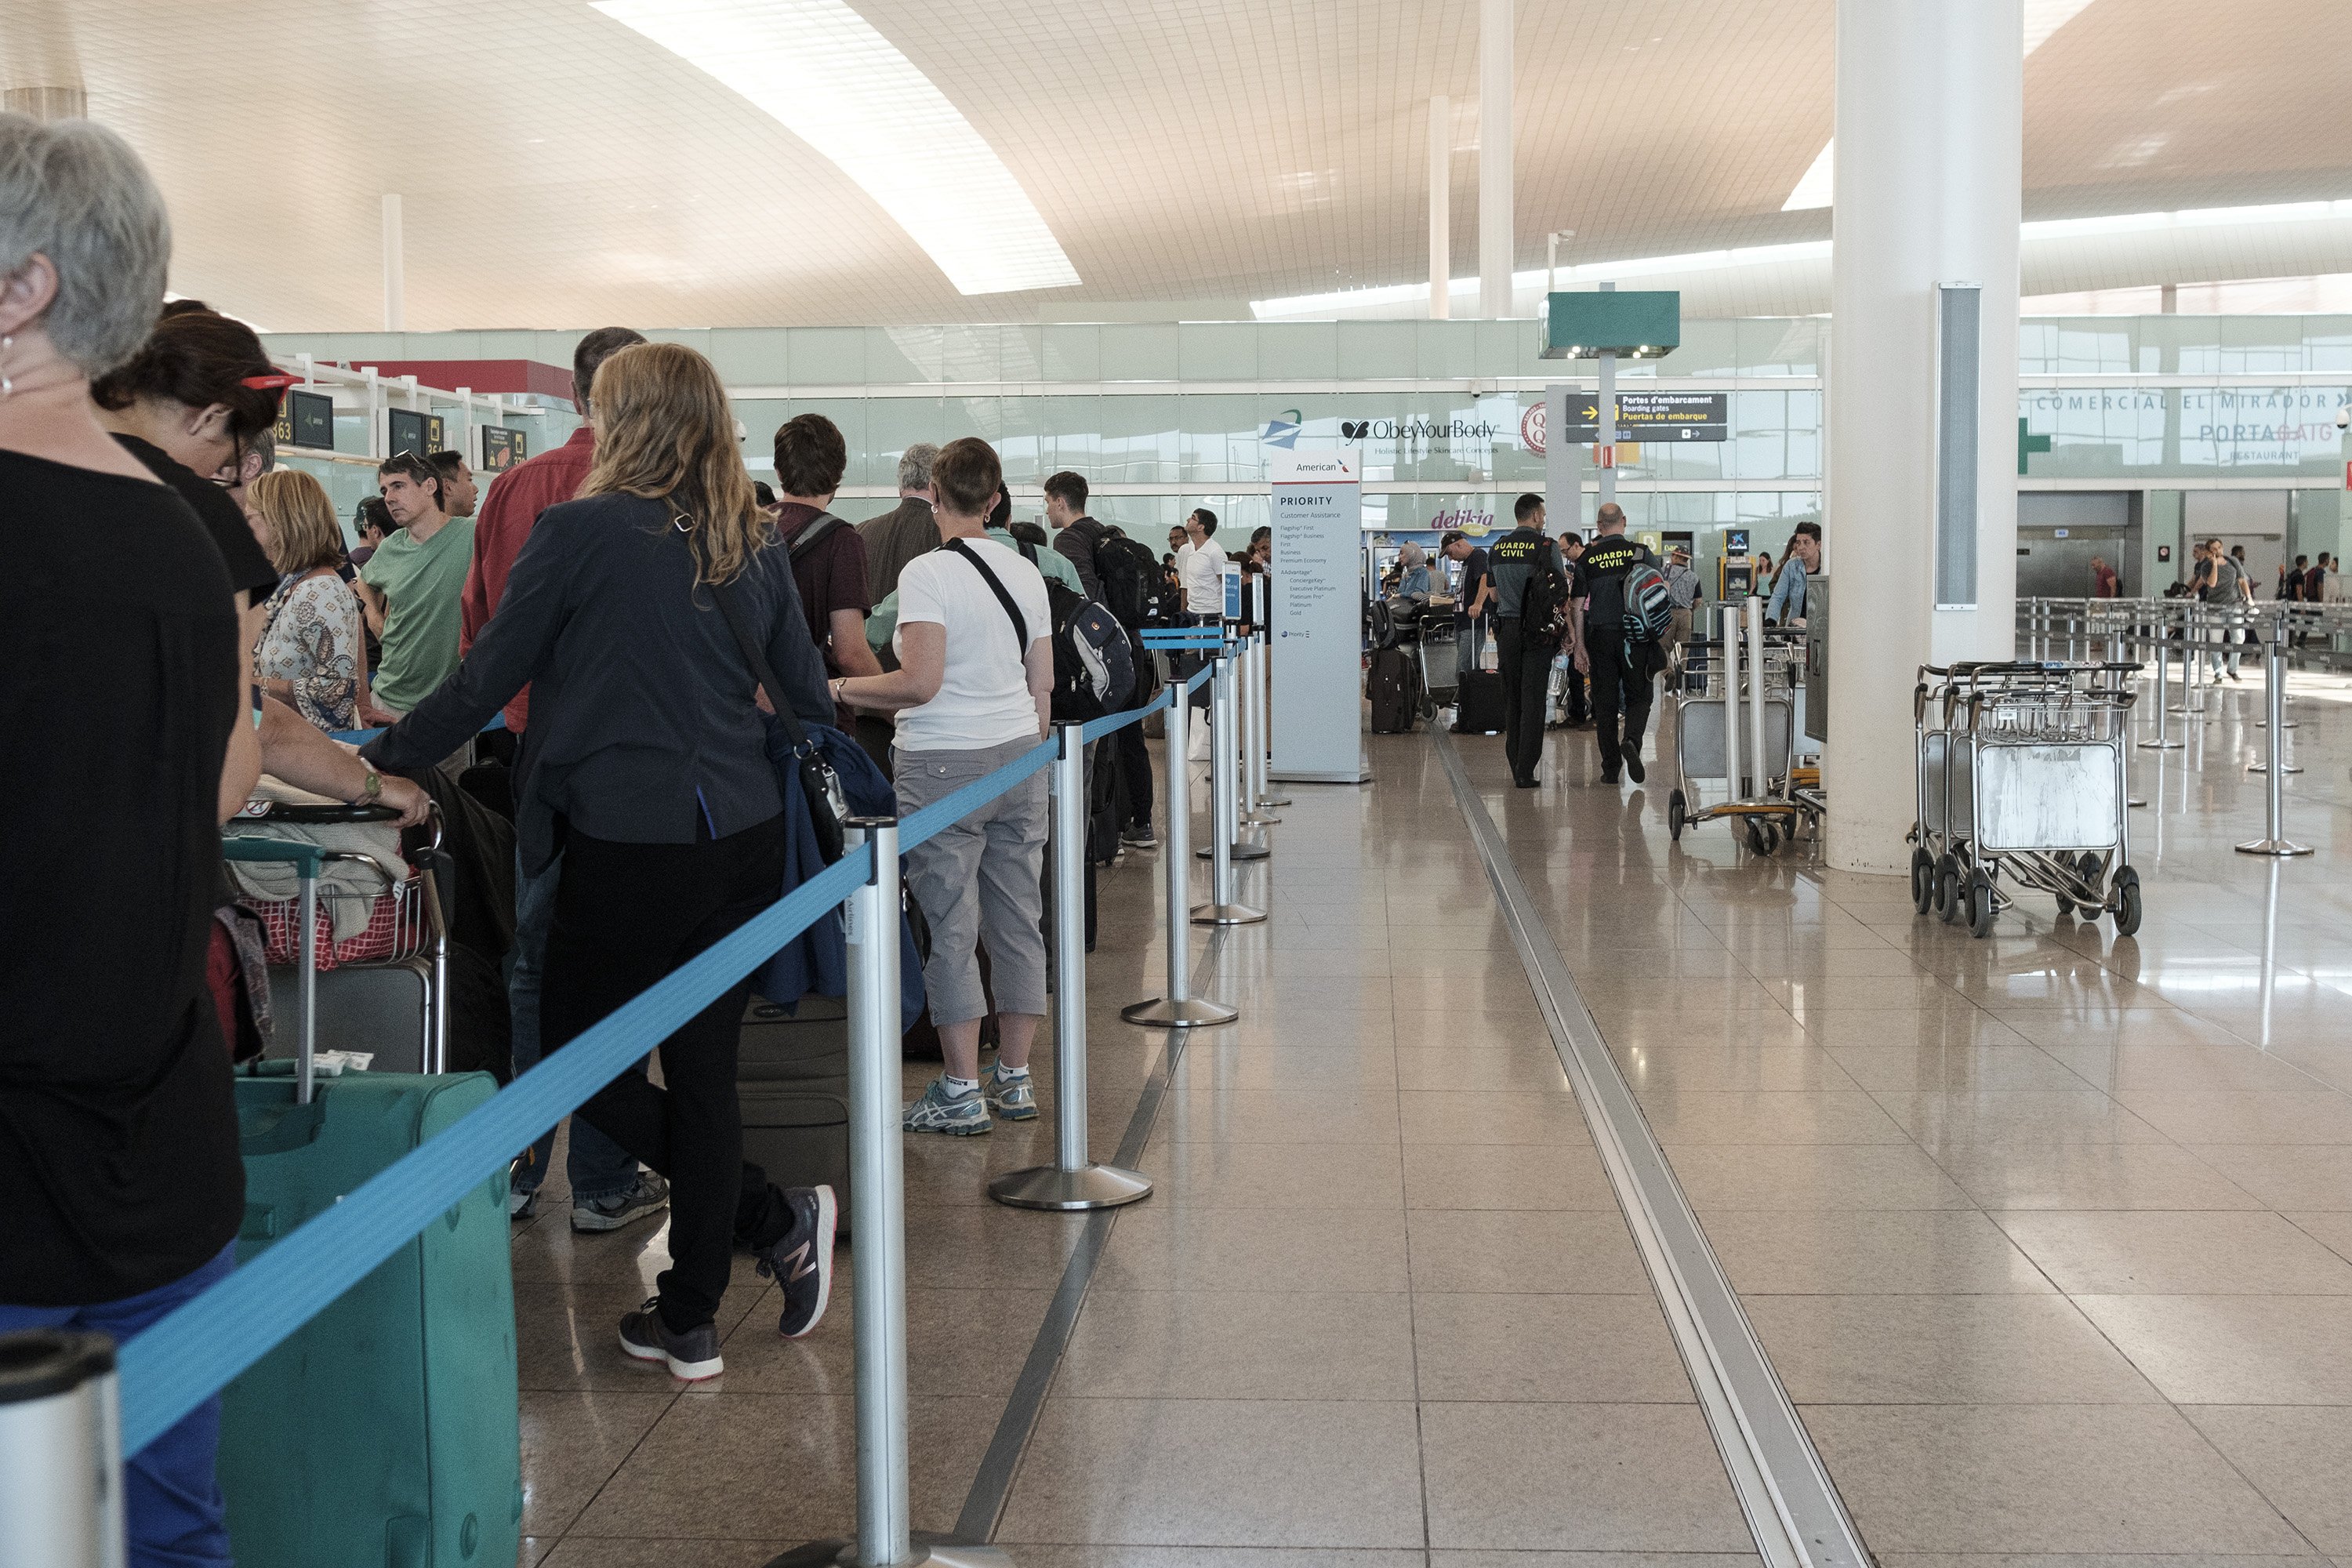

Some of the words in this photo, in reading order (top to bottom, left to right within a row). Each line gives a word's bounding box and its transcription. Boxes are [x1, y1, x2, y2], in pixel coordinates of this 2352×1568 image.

[1622, 396, 1649, 405] Portes
[1650, 396, 1713, 405] d'embarcament
[2037, 395, 2167, 410] COMERCIAL
[2184, 395, 2205, 410] EL
[2221, 394, 2327, 410] MIRADOR
[1622, 405, 1650, 413] Boarding
[1668, 412, 1708, 421] embarque
[1403, 447, 1432, 456] Lifestyle
[1434, 446, 1464, 455] Skincare
[1465, 447, 1499, 456] Concepts
[2230, 451, 2299, 461] RESTAURANT
[1296, 463, 1336, 471] American
[1280, 496, 1332, 506] PRIORITY
[1431, 509, 1494, 529] delikia
[1494, 542, 1536, 551] GUARDIA
[1588, 550, 1634, 564] GUARDIA
[1599, 558, 1624, 569] CIVIL
